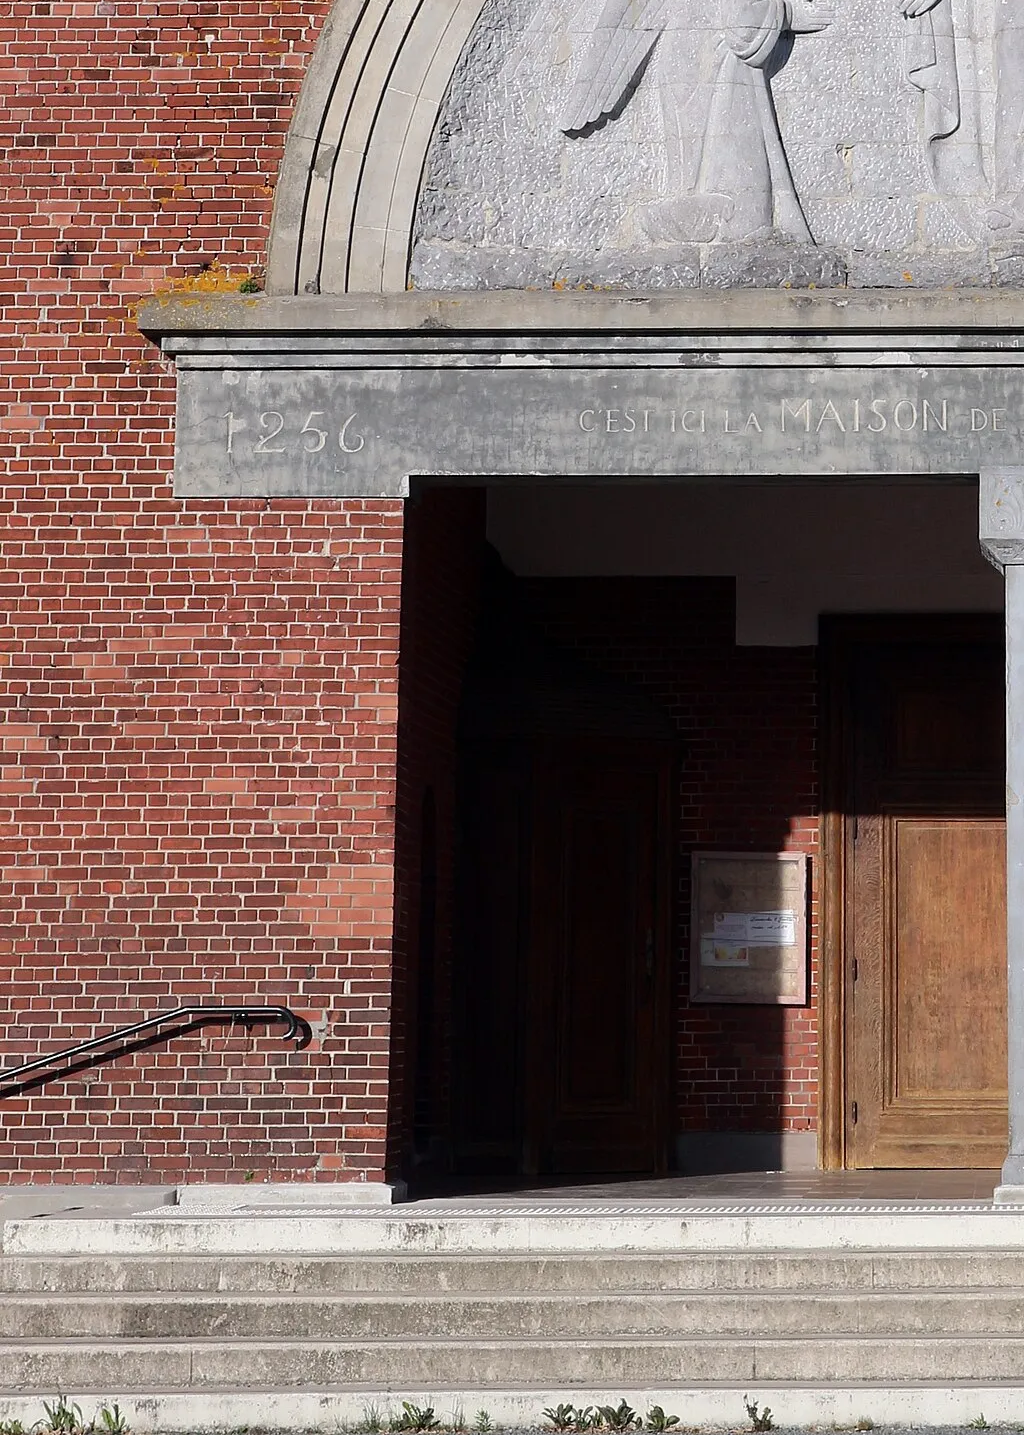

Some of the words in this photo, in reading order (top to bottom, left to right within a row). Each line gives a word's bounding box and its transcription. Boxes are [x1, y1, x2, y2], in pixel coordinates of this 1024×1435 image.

[222, 410, 366, 454] 1256
[578, 409, 654, 433] C'EST
[670, 409, 706, 433] ICI
[723, 409, 764, 433] LA
[779, 398, 949, 433] MAISON
[969, 408, 1008, 433] DE
